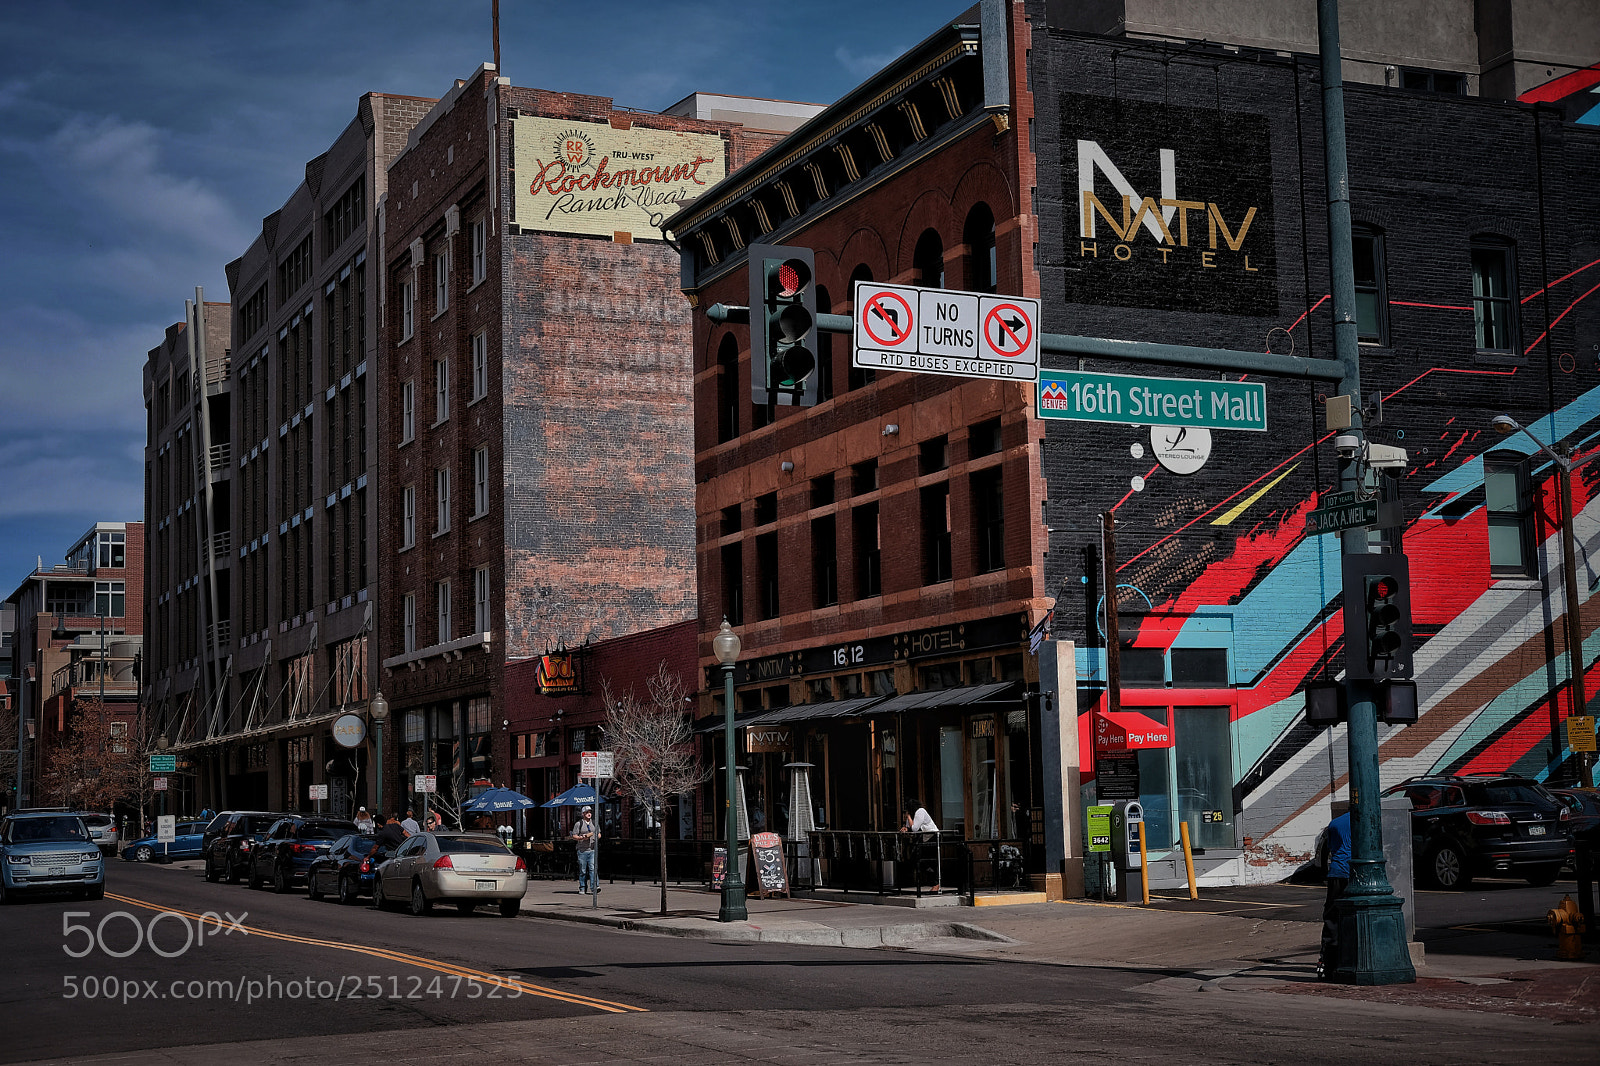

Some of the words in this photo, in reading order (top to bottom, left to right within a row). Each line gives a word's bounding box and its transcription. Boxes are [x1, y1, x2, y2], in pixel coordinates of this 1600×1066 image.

[612, 150, 655, 161] TRU-WEST
[530, 155, 715, 196] Rockmount
[545, 186, 630, 220] Ranch
[632, 185, 687, 208] Wear
[1080, 241, 1258, 271] HOTEL
[936, 302, 959, 322] NO
[923, 326, 974, 348] TURNS
[880, 353, 903, 366] RTD
[909, 355, 949, 370] BUSES
[955, 361, 1014, 376] EXCEPTED
[1042, 398, 1068, 410] DENVER
[1071, 382, 1122, 415] 16th
[1129, 386, 1203, 419] Street
[1211, 391, 1261, 422] Mall
[1327, 496, 1338, 507] 107
[1318, 511, 1340, 530] JACK
[912, 629, 960, 653] HOTEL
[335, 725, 363, 735] PARK
[1128, 733, 1144, 744] Pay
[1147, 732, 1168, 742] Here
[1098, 735, 1109, 746] Pay
[1109, 734, 1124, 744] Here
[1213, 811, 1223, 821] 25
[754, 833, 779, 842] DALE'S
